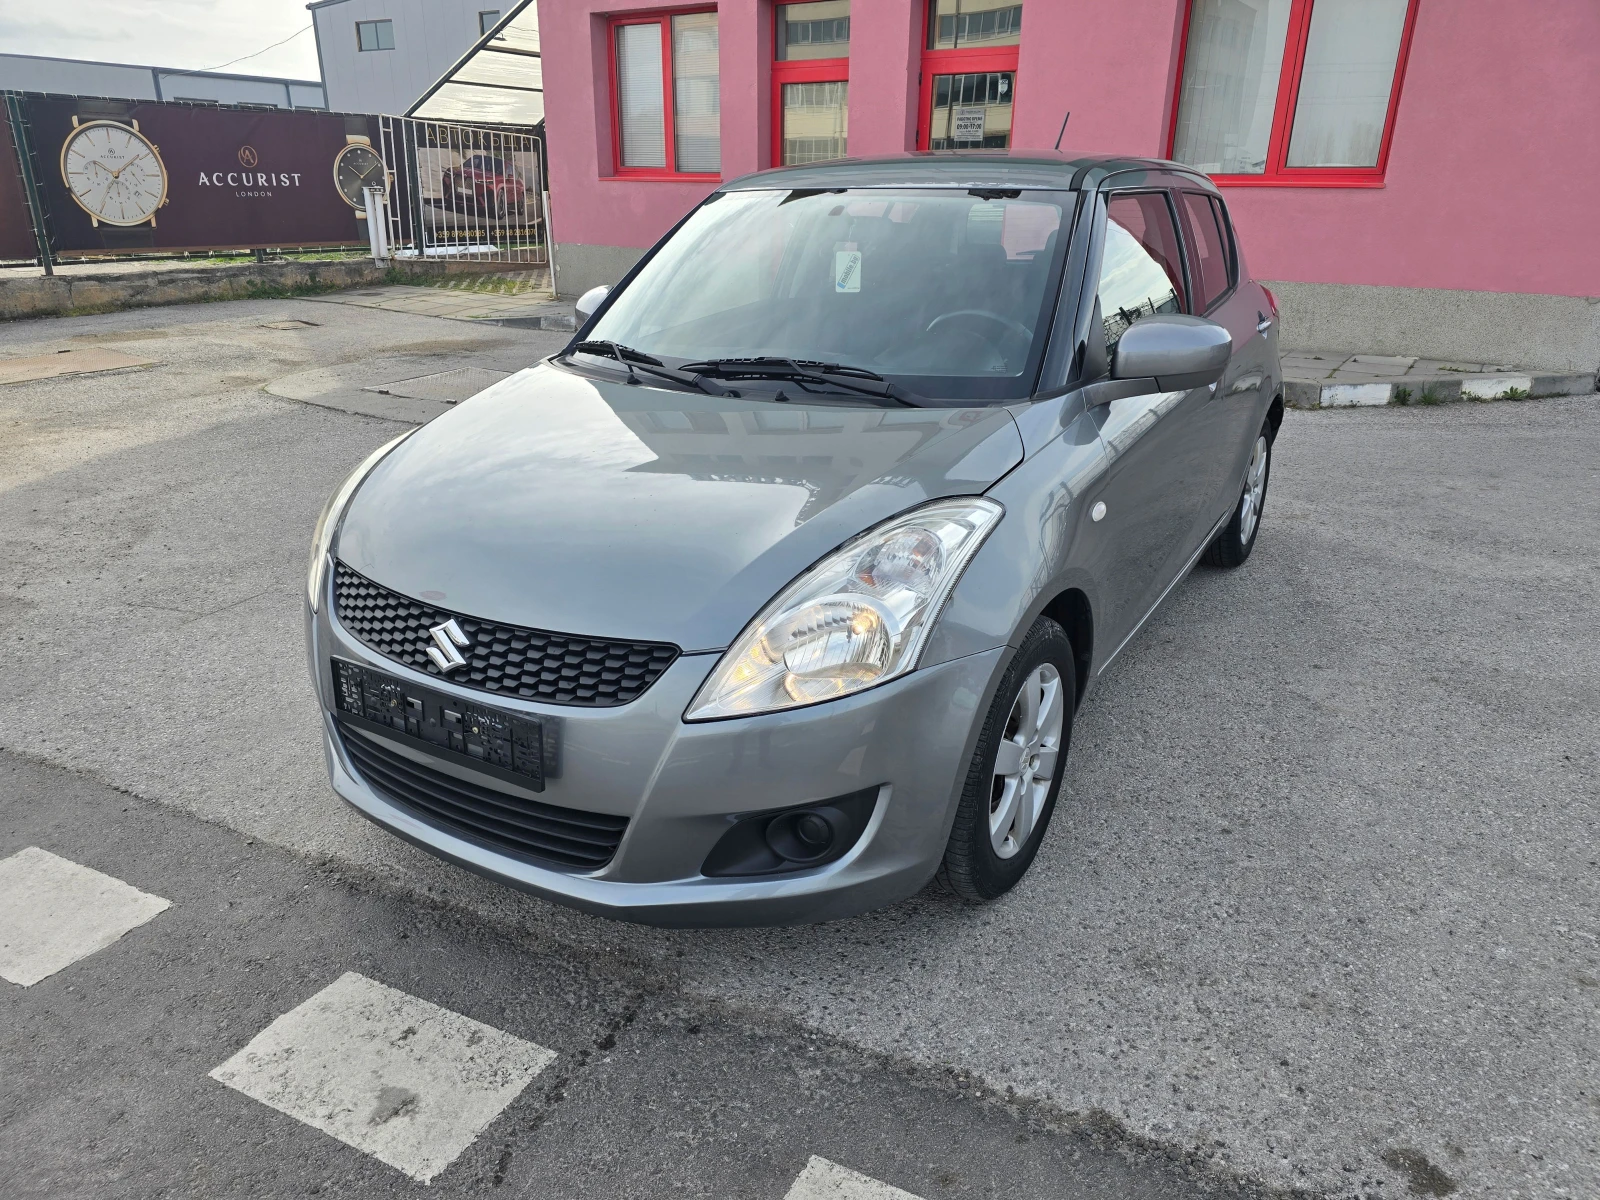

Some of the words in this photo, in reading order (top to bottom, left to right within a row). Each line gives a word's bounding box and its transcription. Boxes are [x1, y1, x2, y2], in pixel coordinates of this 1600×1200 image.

[427, 127, 530, 150] АВТОКЪЩА
[198, 172, 302, 187] ACCURIST
[490, 229, 505, 237] +359
[840, 256, 858, 284] mobile.bg
